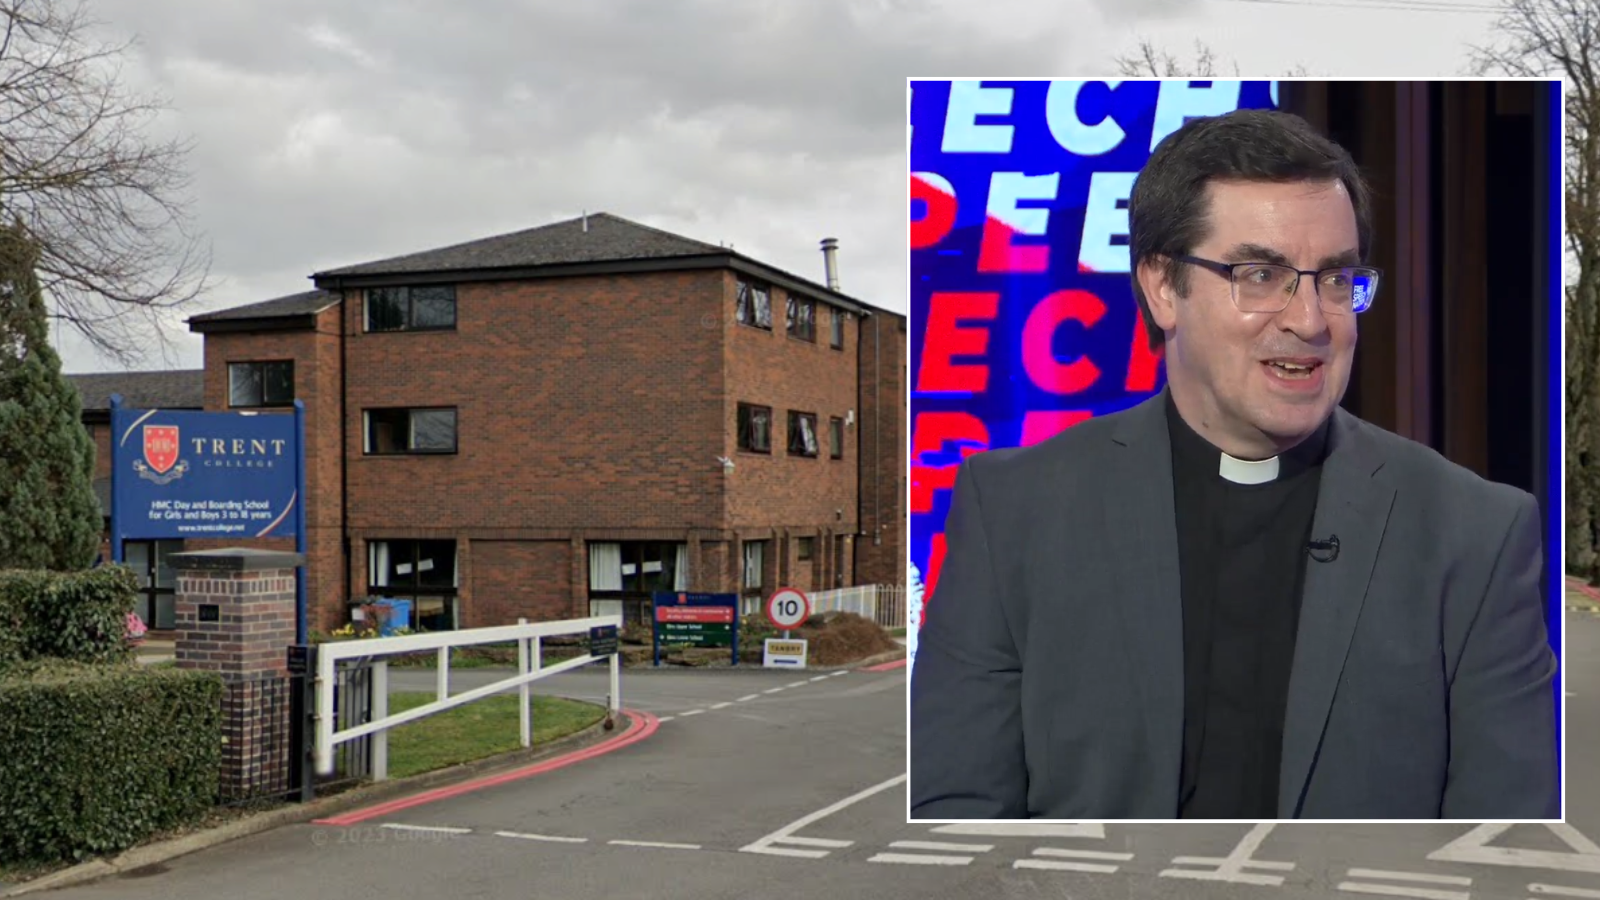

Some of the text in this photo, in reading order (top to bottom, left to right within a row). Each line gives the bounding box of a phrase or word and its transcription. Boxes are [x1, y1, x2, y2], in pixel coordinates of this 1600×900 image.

[191, 438, 286, 456] TRENT
[204, 460, 274, 468] COLLEGE
[151, 500, 270, 511] HMC Day and Boarding School
[148, 511, 272, 521] for Girls and Boys 3 to 18 years
[178, 524, 246, 533] www.trentcollege.net
[777, 599, 798, 616] 10
